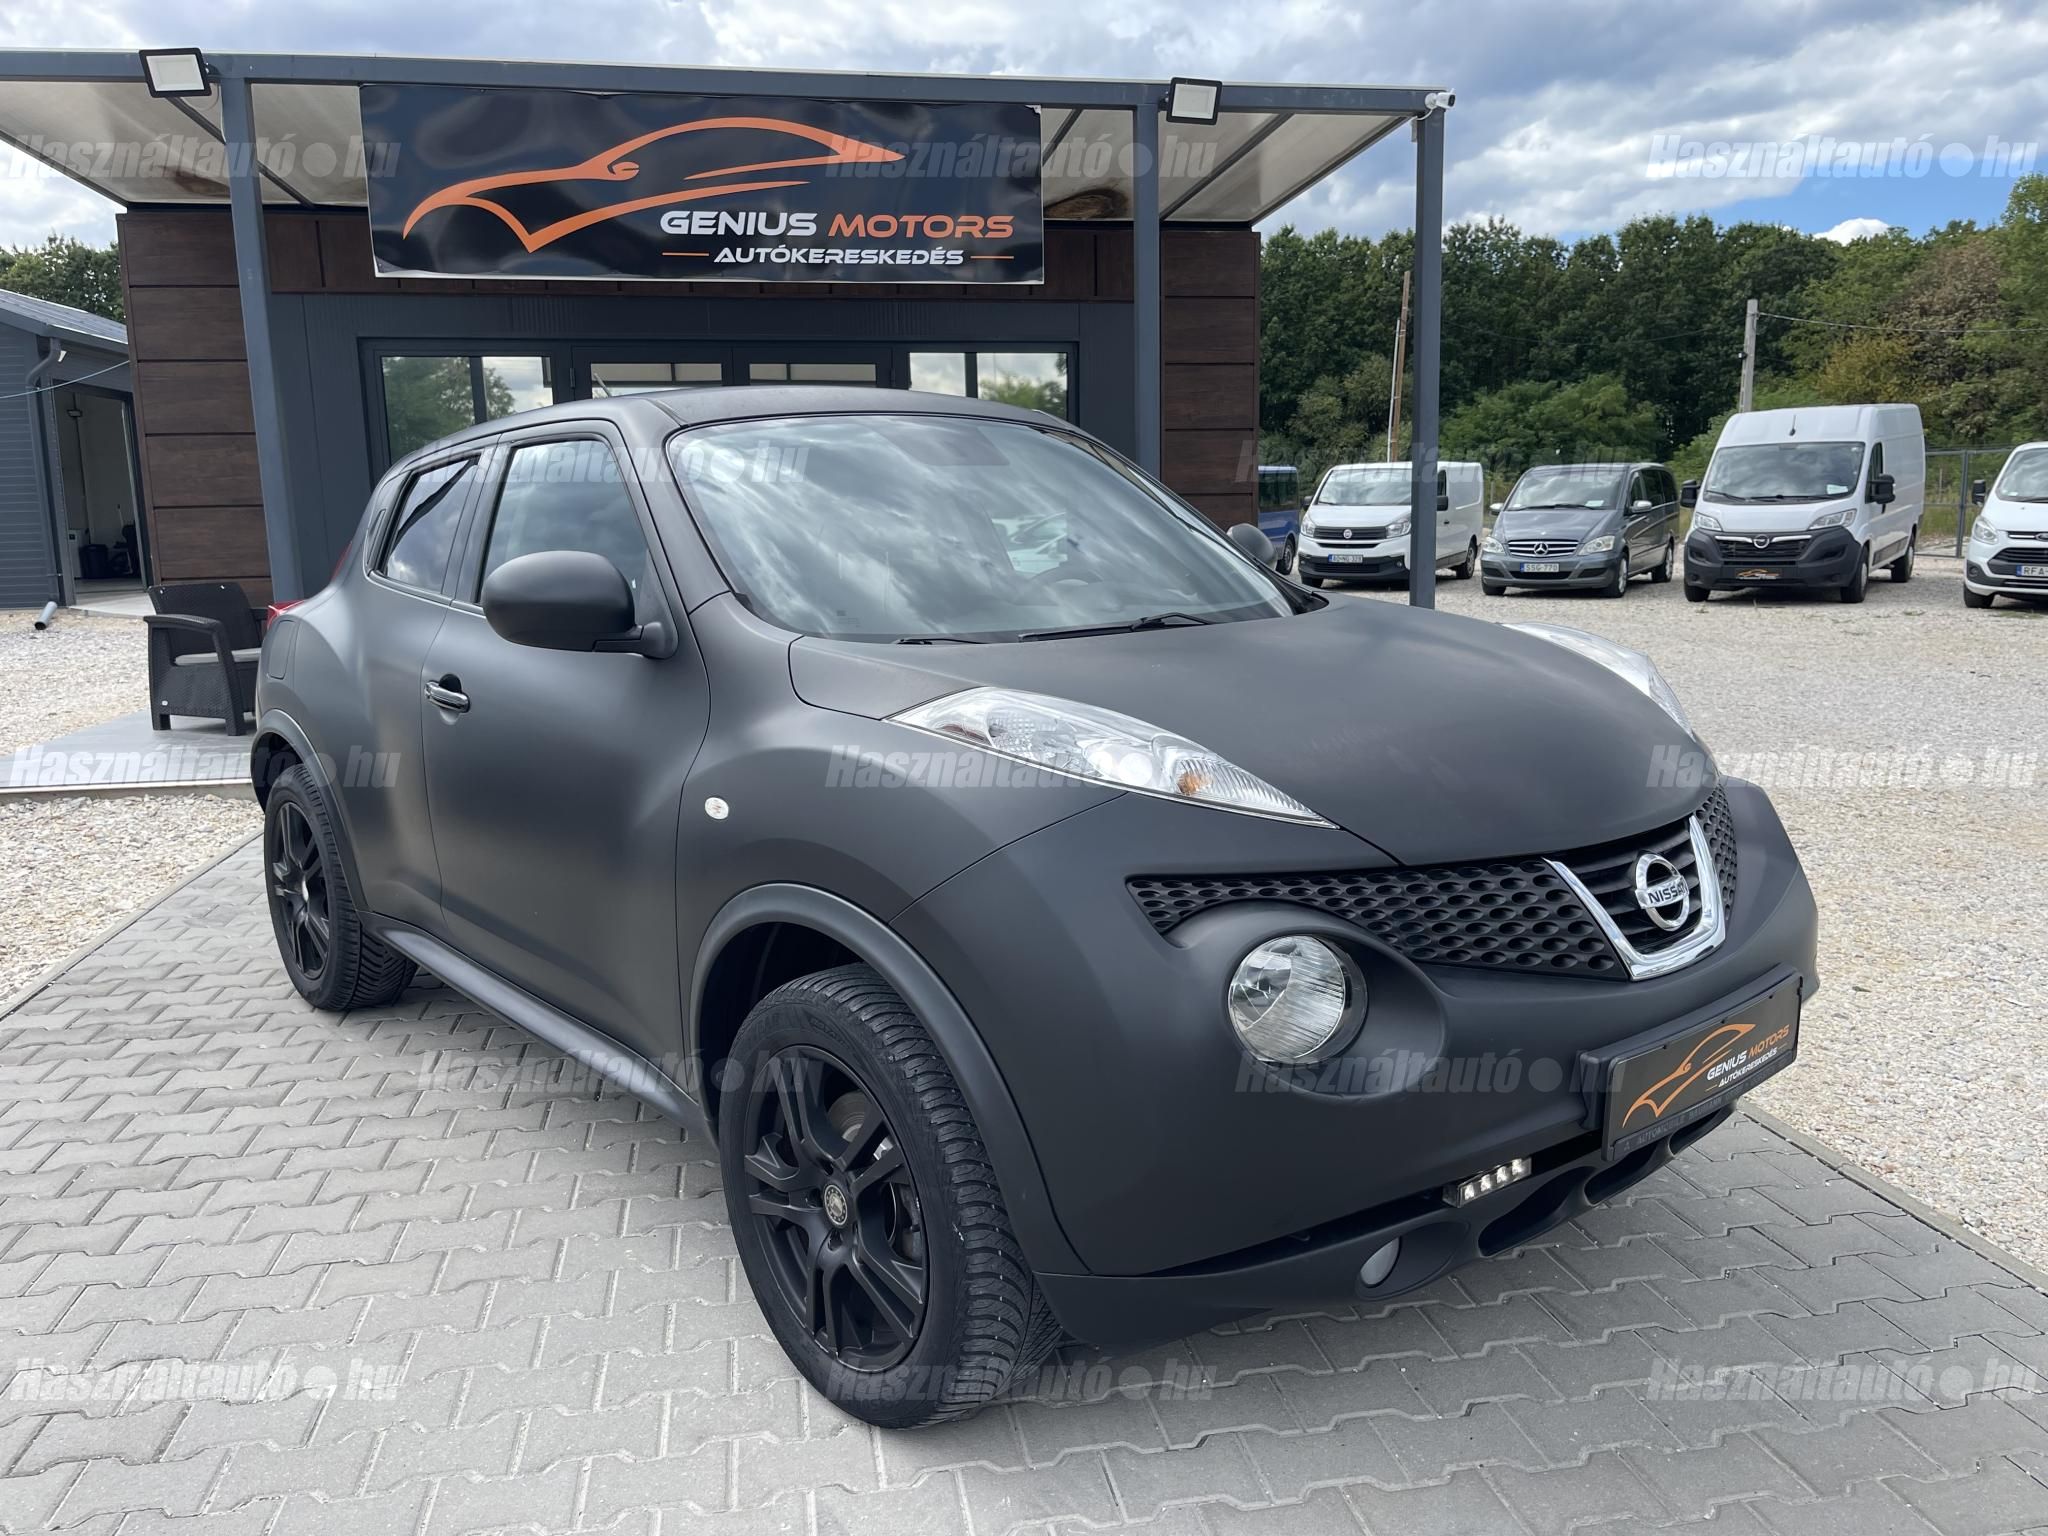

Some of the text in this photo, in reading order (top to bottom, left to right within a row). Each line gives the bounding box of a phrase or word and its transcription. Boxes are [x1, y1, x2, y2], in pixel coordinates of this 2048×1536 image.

[660, 210, 1015, 239] GENIUS MOTORS
[713, 245, 964, 266] AUTÓKERESKEDÉS
[1706, 1024, 1790, 1081] GENIUS MOTORS
